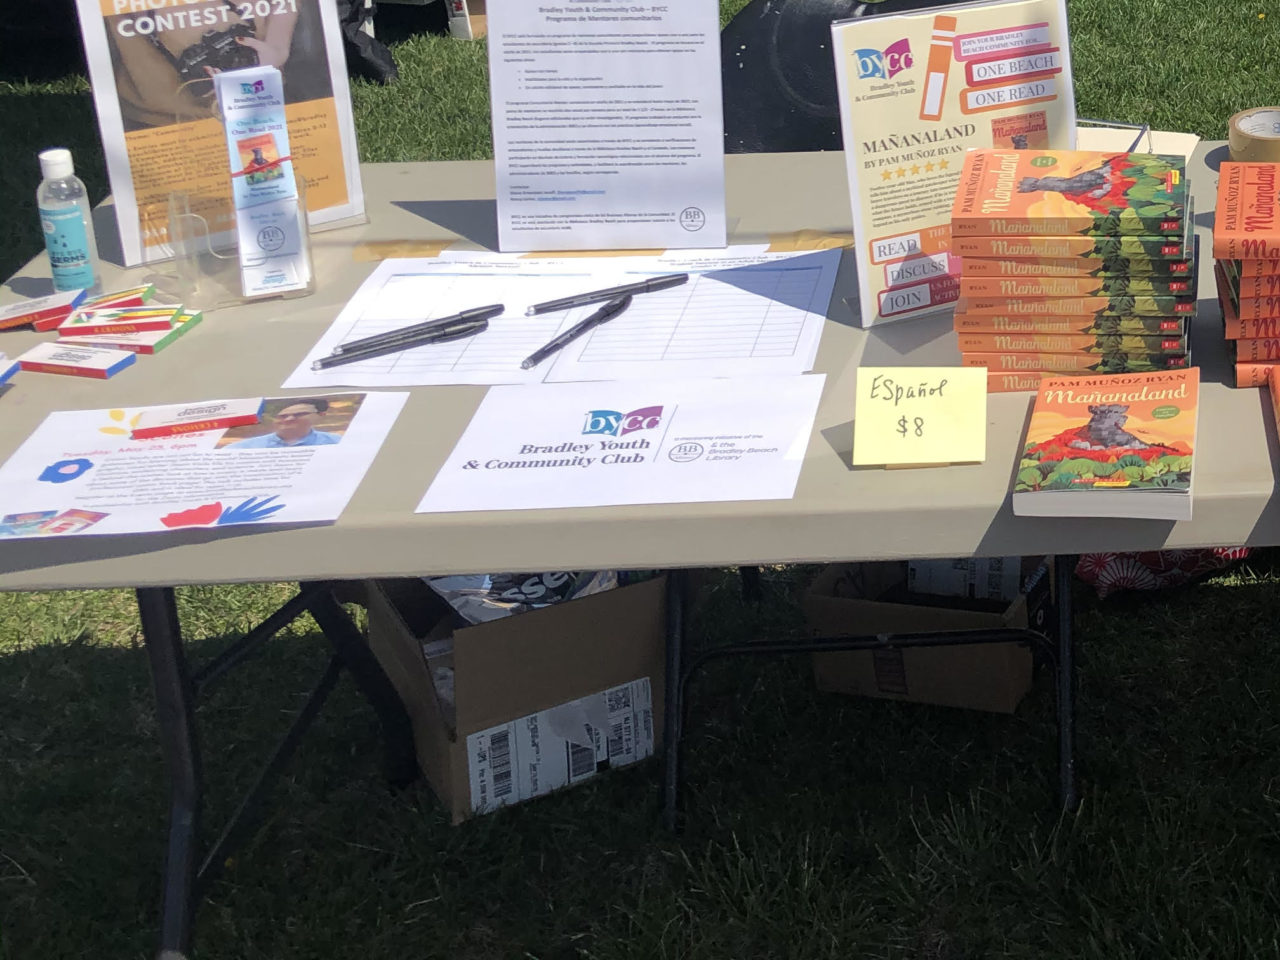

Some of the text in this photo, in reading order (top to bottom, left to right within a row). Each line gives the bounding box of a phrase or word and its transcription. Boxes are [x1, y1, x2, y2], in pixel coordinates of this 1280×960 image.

[116, 4, 238, 38] CONTEST
[855, 49, 913, 78] bycc
[977, 56, 1054, 78] ONE BEACH
[975, 84, 1045, 106] ONE READ
[862, 123, 976, 155] MAÑANALAND
[864, 144, 963, 169] BY PAM MUÑOZ RYAN
[962, 153, 985, 213] PAM MUÑOZ RYAN
[981, 153, 1020, 214] Mañanaland
[1225, 166, 1240, 230] PAM MUÑOZ RYAN
[1244, 165, 1276, 232] Mañanaland
[989, 219, 1070, 234] Mañanaland
[877, 239, 917, 258] READ
[991, 241, 1070, 256] Mañanaland
[891, 260, 946, 282] DISCUSS
[999, 260, 1079, 275] Mañanaland
[1000, 280, 1080, 296] Mañanaland
[890, 291, 922, 311] JOIN
[1006, 298, 1084, 313] Mañanaland
[992, 316, 1070, 332] Mañanaland
[994, 335, 1072, 351] Mañanaland
[1000, 355, 1078, 370] Mañanaland
[1084, 377, 1142, 386] MUÑOZ
[1146, 374, 1187, 383] RYAN
[1045, 383, 1190, 404] Mañanaland
[583, 411, 662, 436] bycc
[896, 415, 924, 438] $8
[519, 438, 651, 455] Bradley Youth
[677, 445, 698, 453] BB
[462, 452, 645, 470] & Community Club
